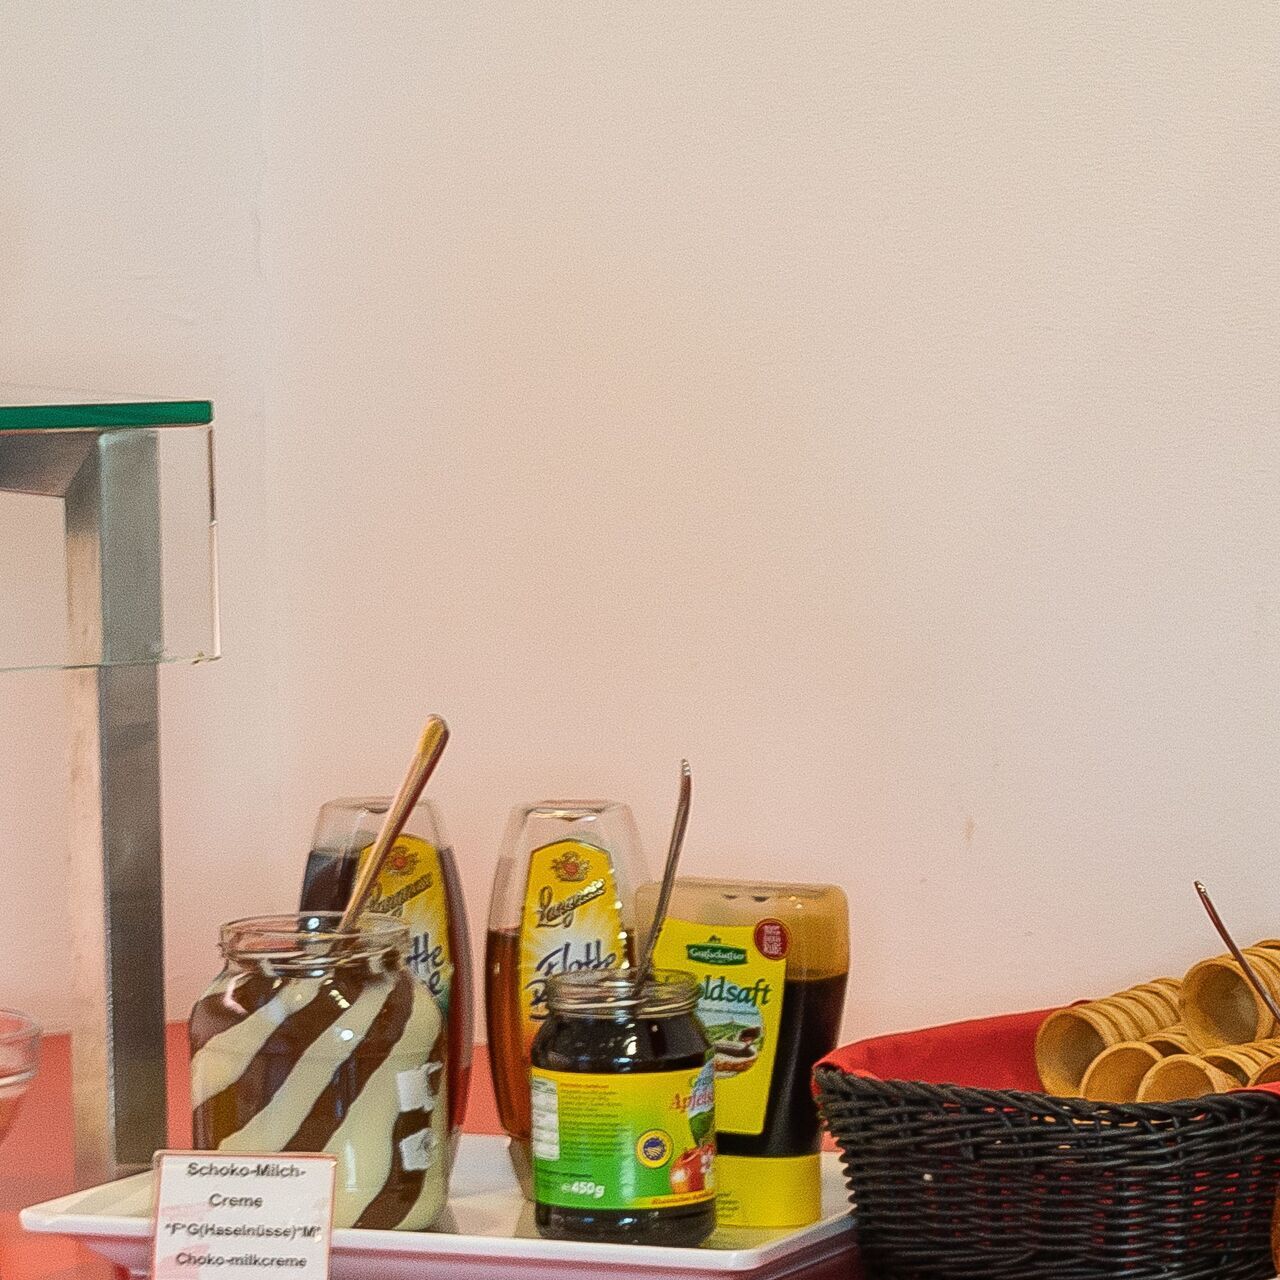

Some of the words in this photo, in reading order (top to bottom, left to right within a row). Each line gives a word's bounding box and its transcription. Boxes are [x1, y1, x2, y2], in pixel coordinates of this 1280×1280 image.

[186, 1161, 307, 1178] Schoko-Milch-
[208, 1193, 263, 1208] Creme
[176, 1252, 307, 1268] Choko-milkcreme
